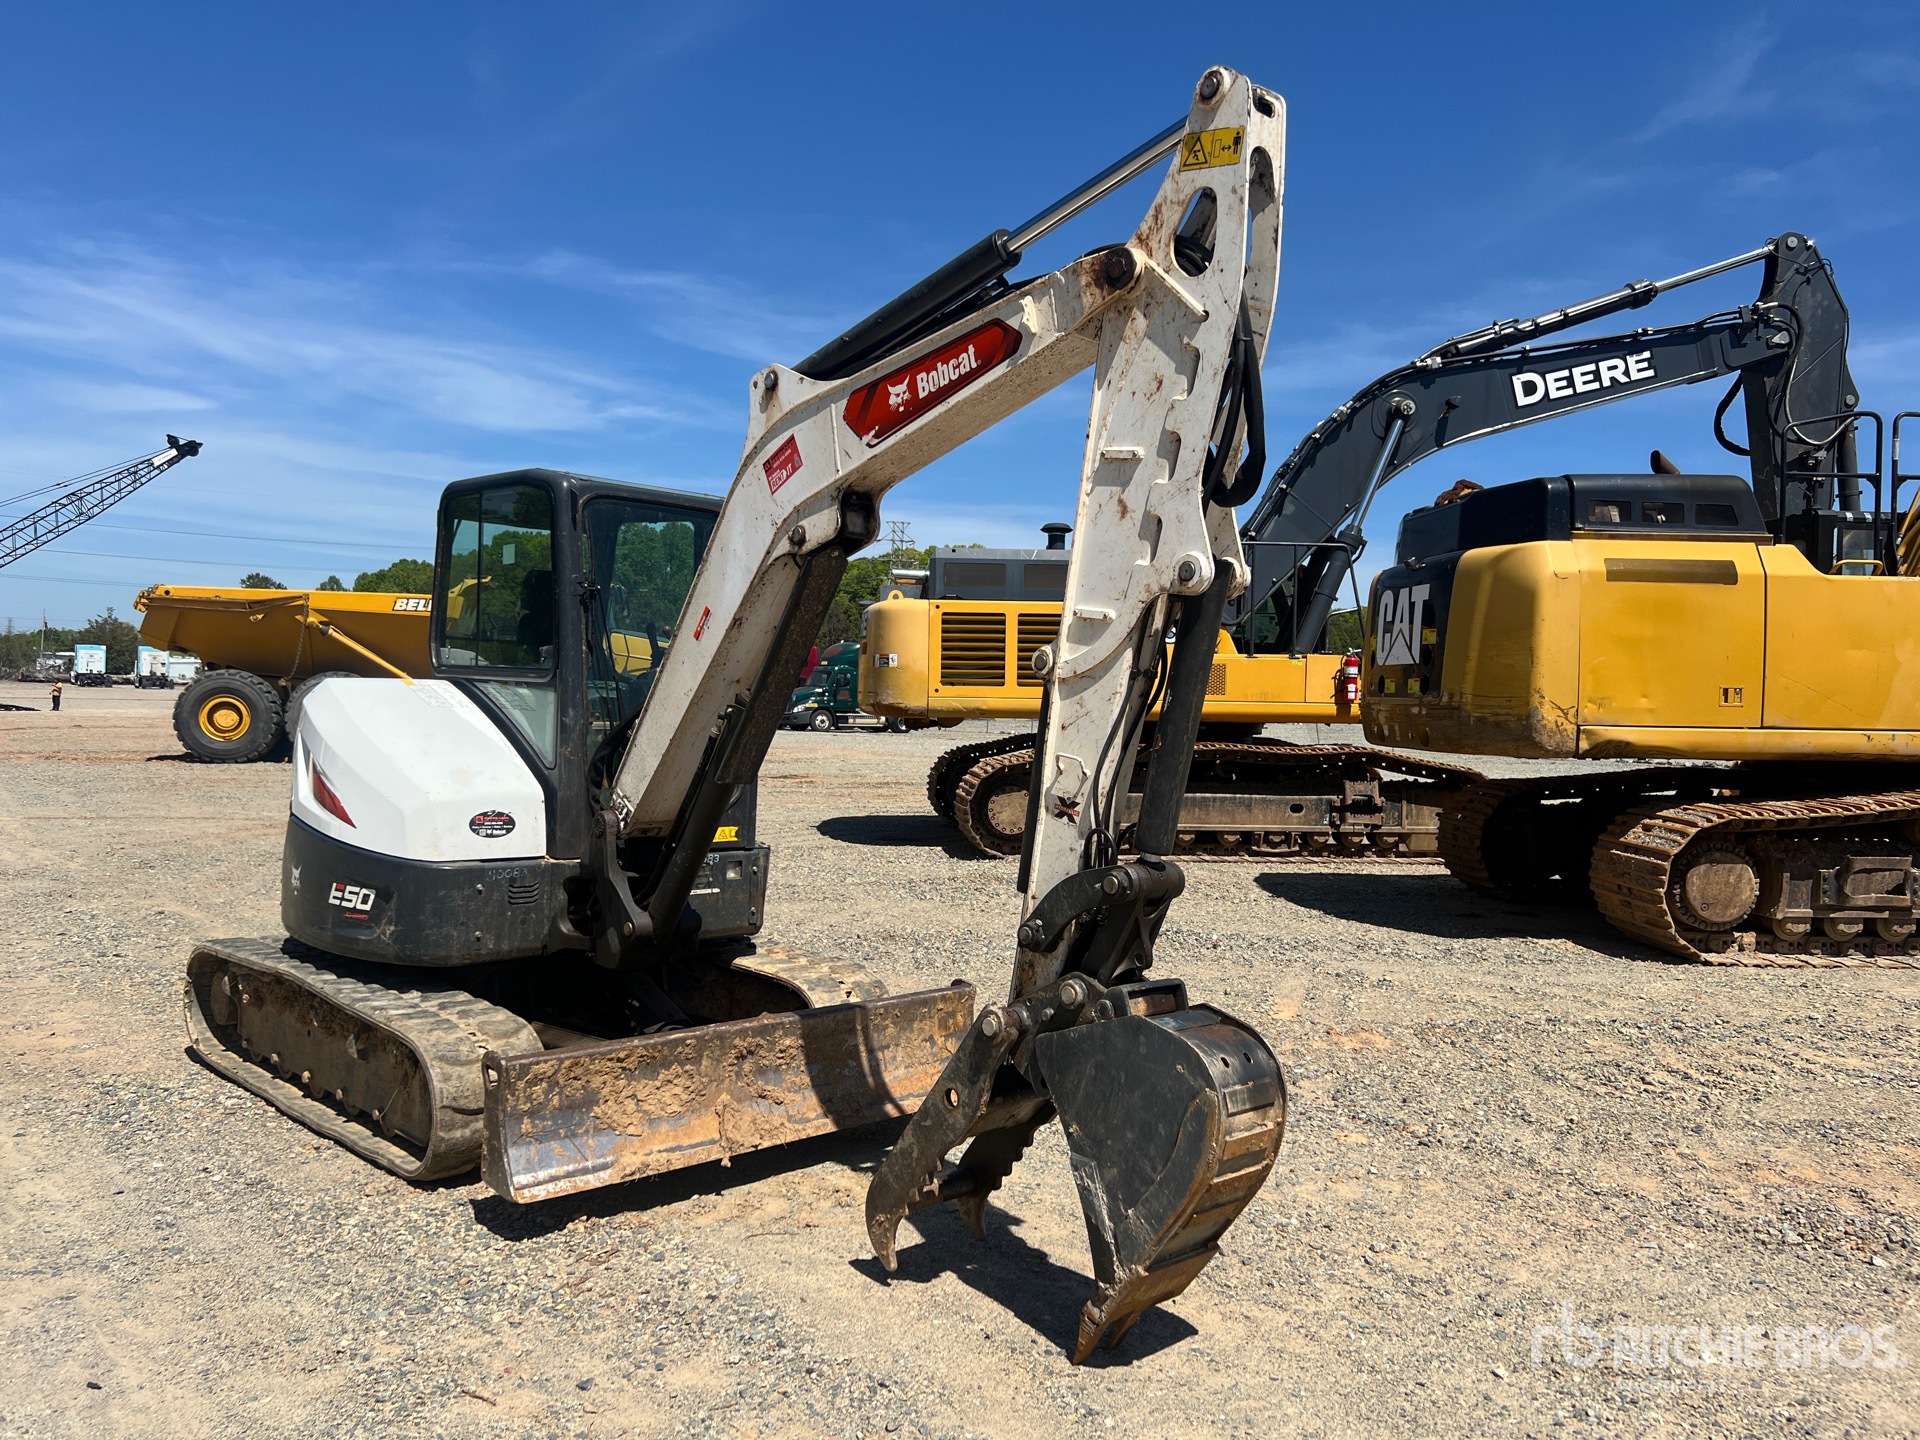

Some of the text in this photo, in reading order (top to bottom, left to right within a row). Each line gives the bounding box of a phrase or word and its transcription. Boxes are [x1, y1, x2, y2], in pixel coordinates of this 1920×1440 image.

[916, 344, 978, 399] Bobcat
[1511, 350, 1655, 407] DEERE
[772, 472, 786, 490] RENT
[1376, 583, 1431, 666] CAT
[328, 882, 377, 911] E50
